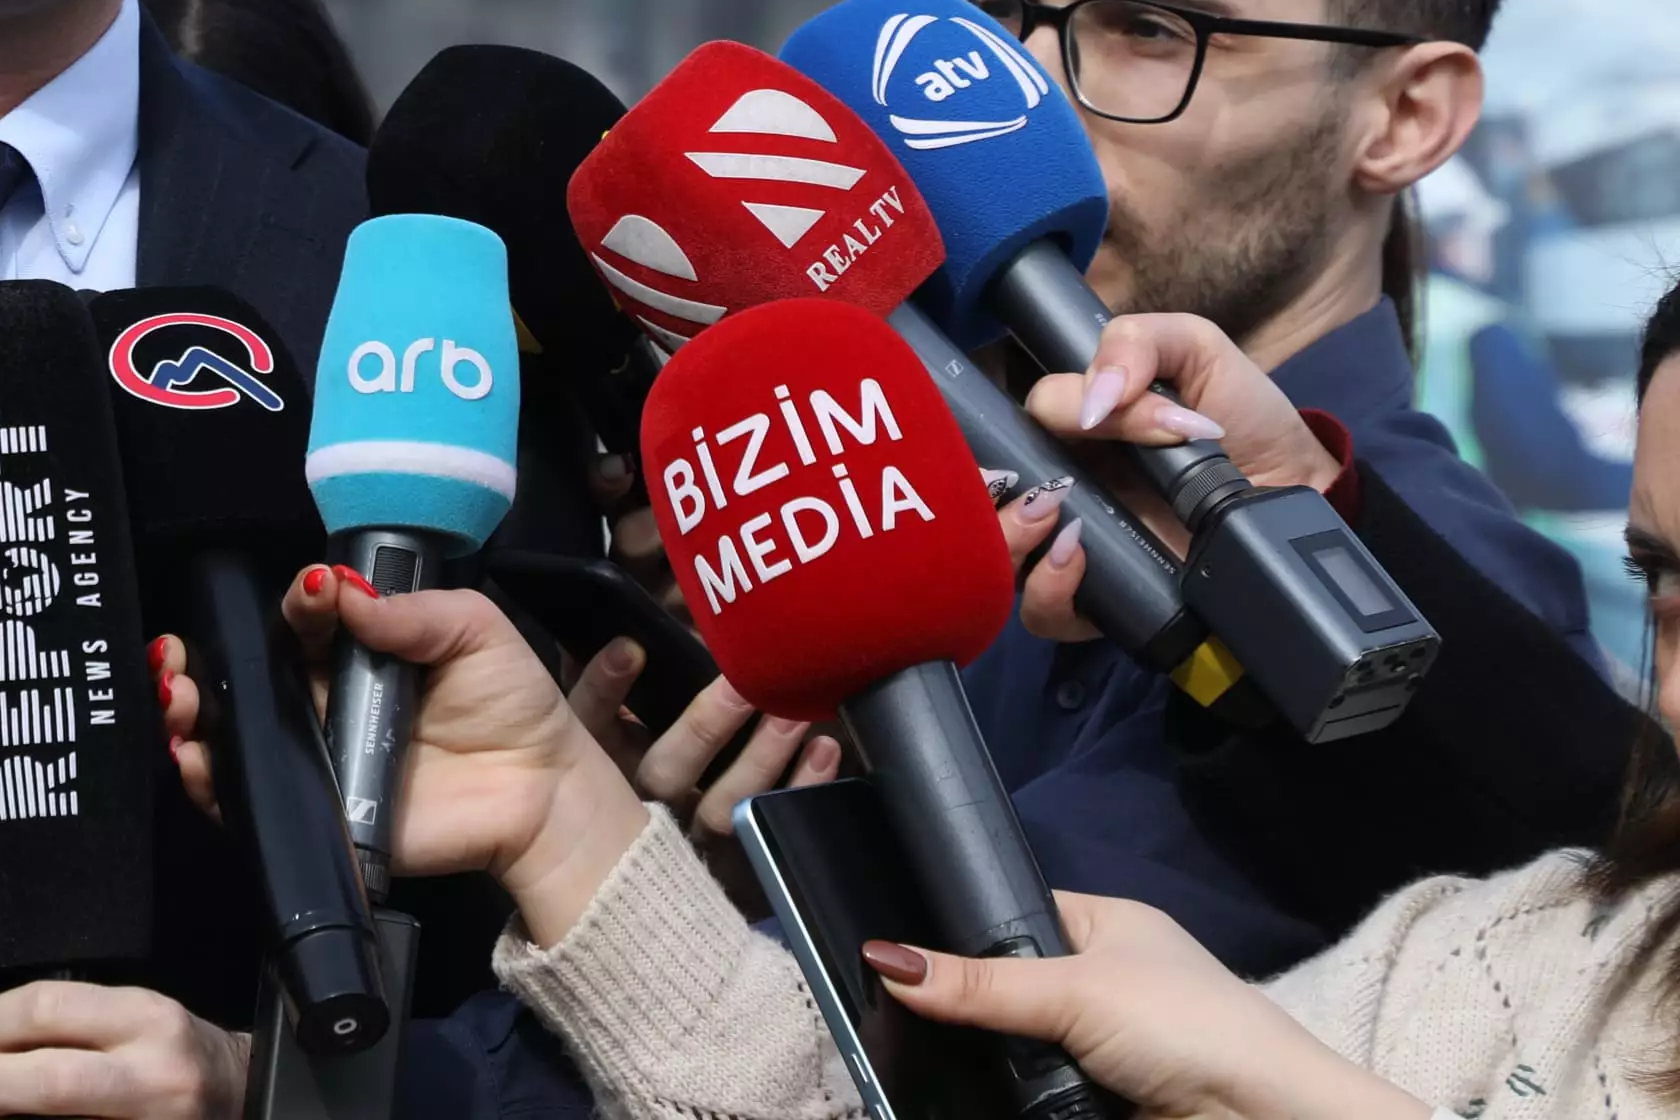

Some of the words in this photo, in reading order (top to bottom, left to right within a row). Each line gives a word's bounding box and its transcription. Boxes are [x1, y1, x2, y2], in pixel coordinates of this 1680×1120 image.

[914, 50, 990, 102] atv
[348, 338, 494, 401] arb
[663, 377, 904, 536] BİZİM
[64, 487, 103, 609] AGENCY
[693, 462, 937, 616] MEDİA
[83, 638, 117, 726] NEWS
[365, 682, 384, 755] SENNHEISER
